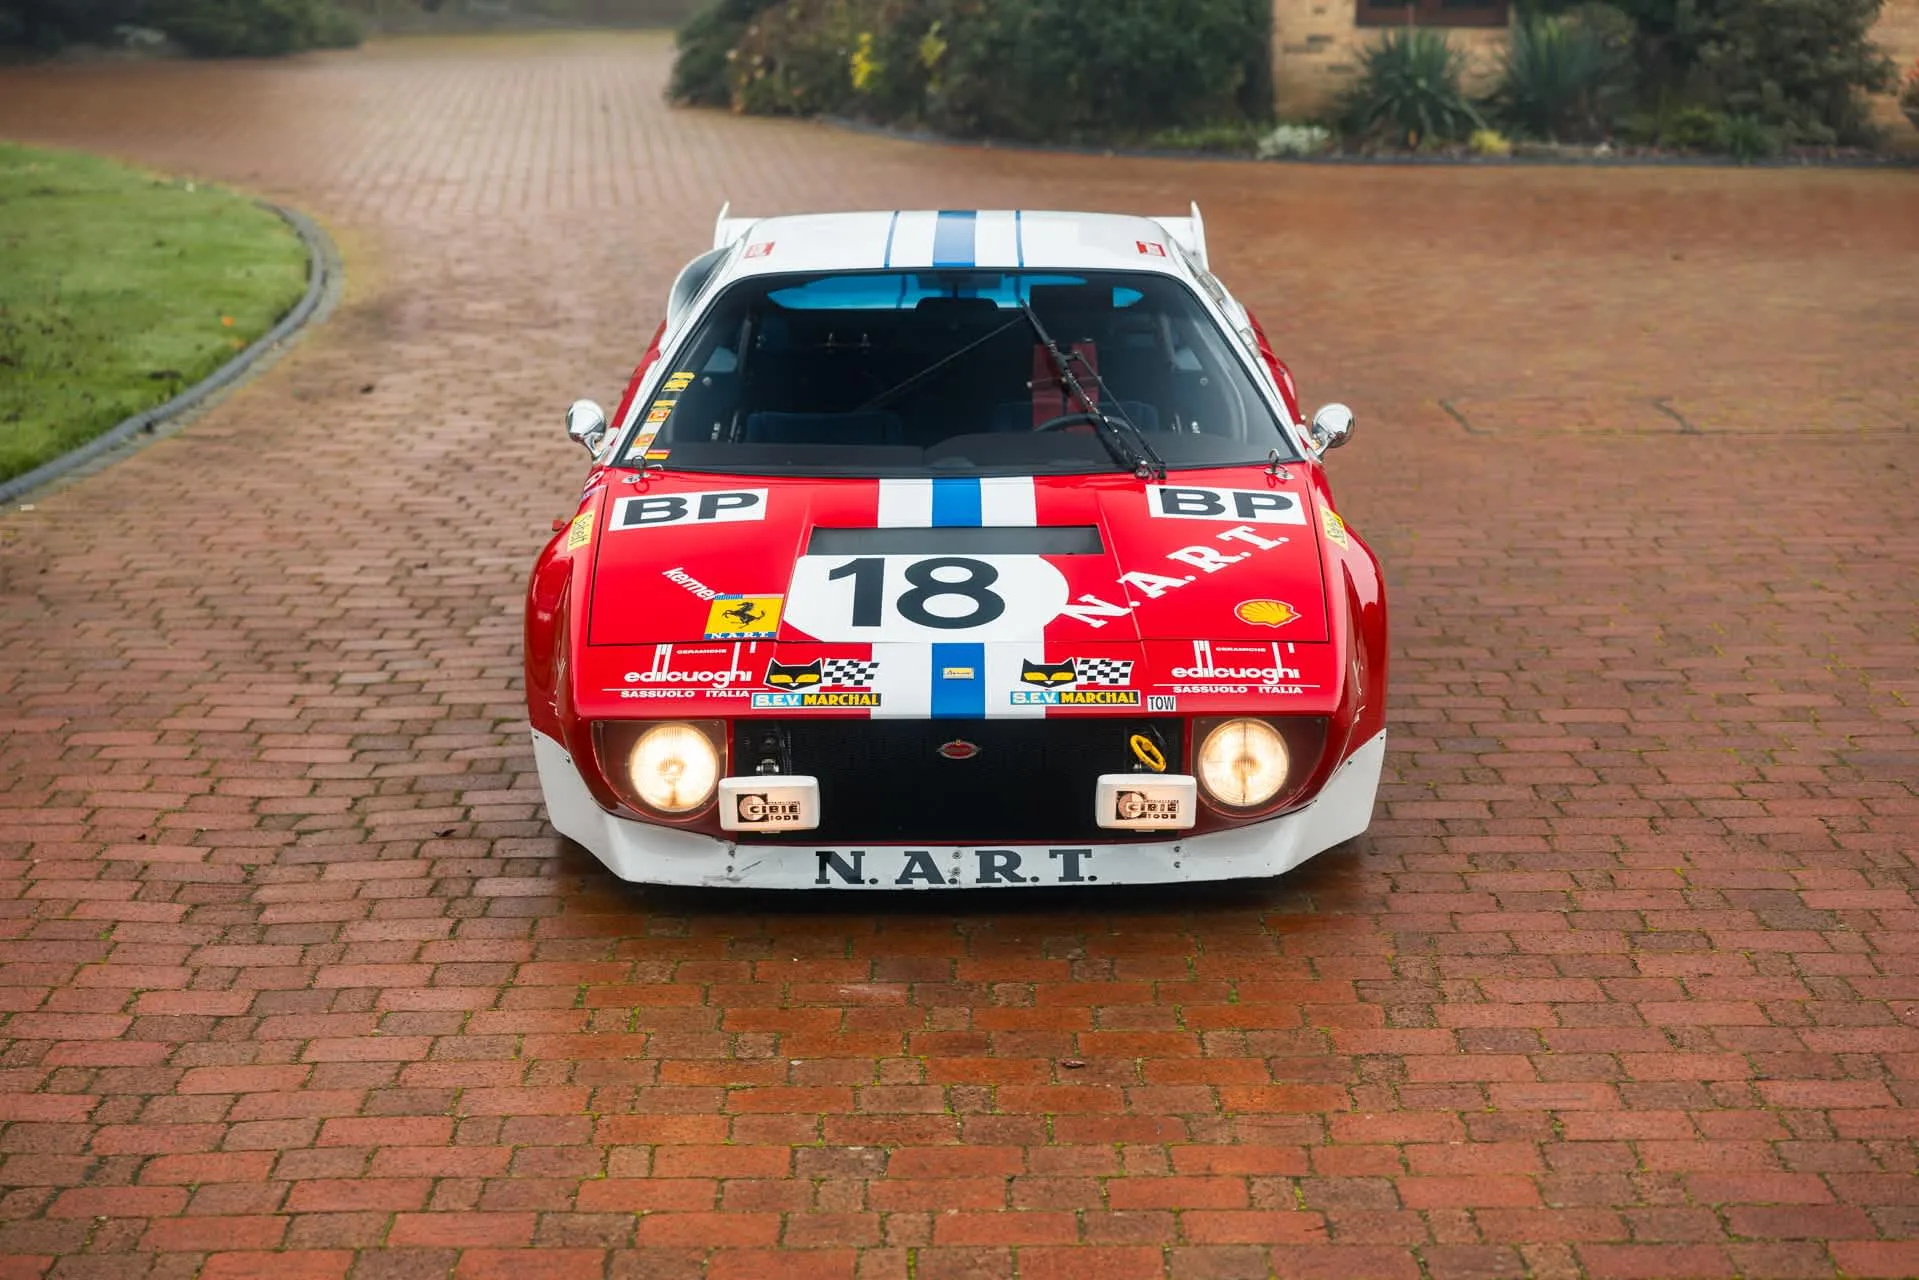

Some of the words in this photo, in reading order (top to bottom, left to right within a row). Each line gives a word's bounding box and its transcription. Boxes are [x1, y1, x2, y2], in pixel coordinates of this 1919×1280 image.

[622, 492, 760, 526] BP
[1159, 487, 1294, 519] BP
[1059, 525, 1290, 629] N.A.R.T.
[828, 556, 1006, 629] 18
[620, 690, 695, 698] SASSUOLO
[705, 690, 750, 698] ITALIA
[1173, 686, 1248, 694] SASSUOLO
[1258, 686, 1303, 694] ITALIA
[803, 694, 879, 706] MARCHAL
[1061, 692, 1137, 704] MARCHAL
[1149, 696, 1175, 711] TOW
